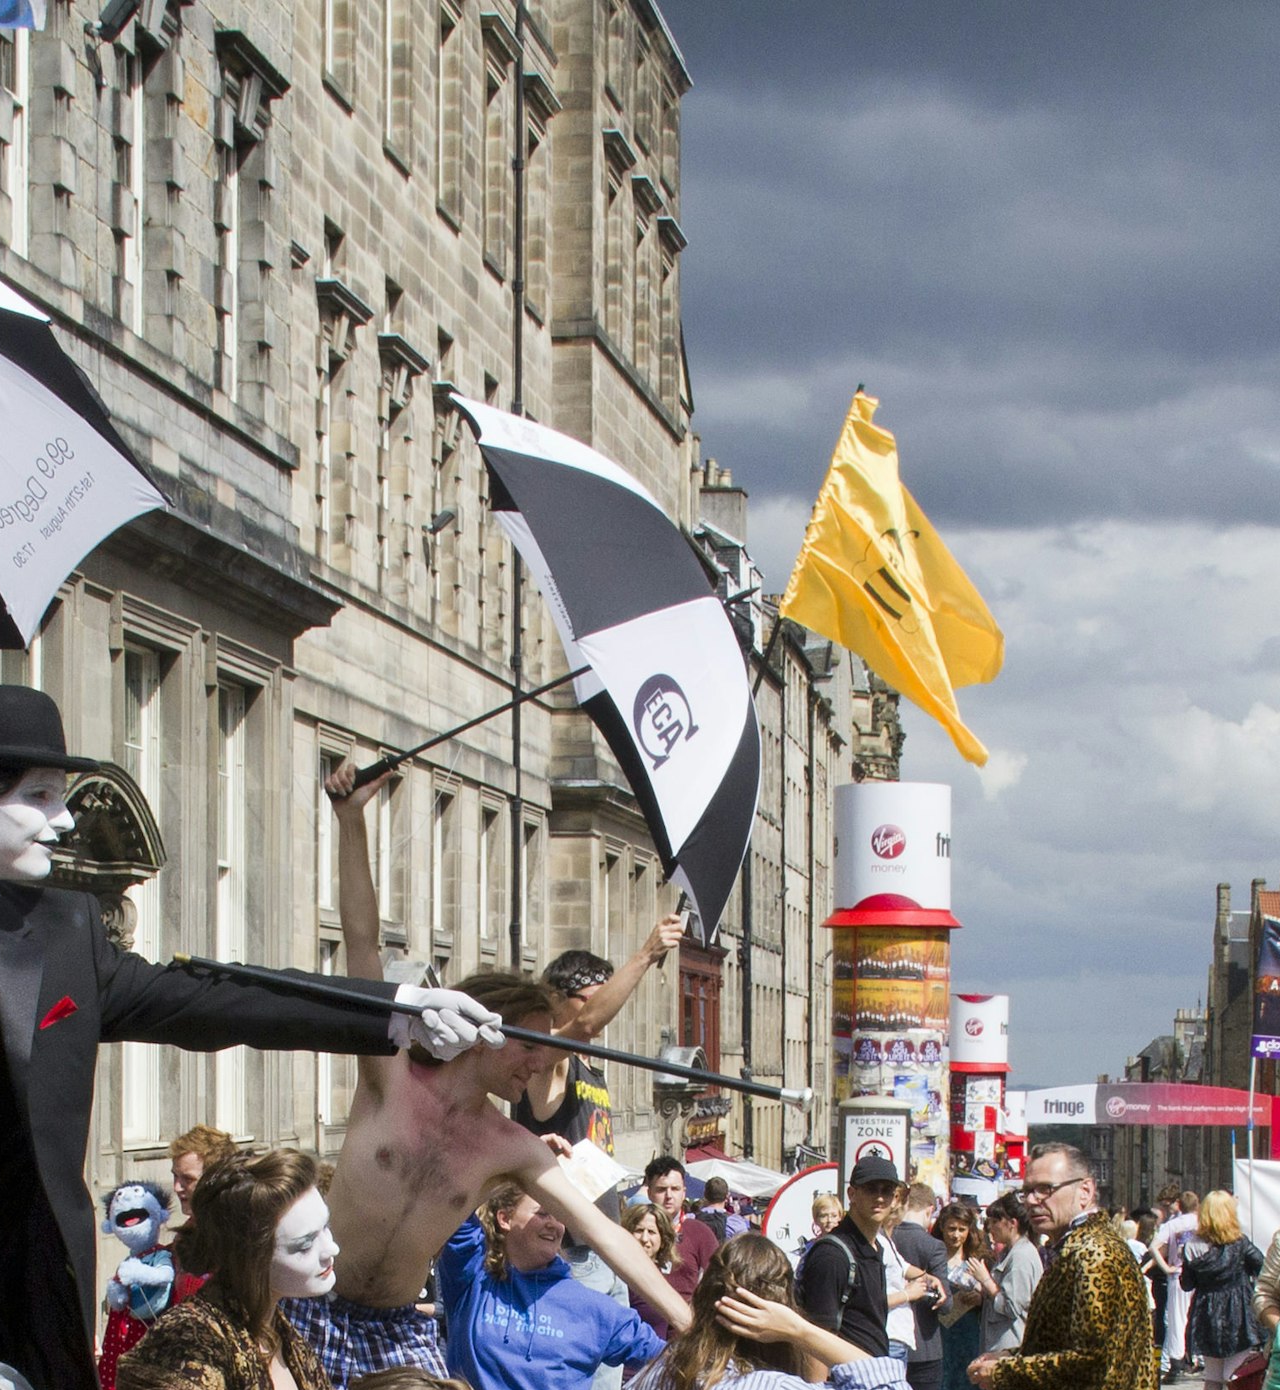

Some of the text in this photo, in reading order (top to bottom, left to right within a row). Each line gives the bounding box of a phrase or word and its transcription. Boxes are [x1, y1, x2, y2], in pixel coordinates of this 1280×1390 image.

[644, 688, 684, 755] ECA
[873, 828, 905, 857] Virgin
[871, 864, 907, 874] money
[1044, 1098, 1085, 1116] fringe
[1125, 1104, 1151, 1113] money
[857, 1127, 893, 1137] ZONE
